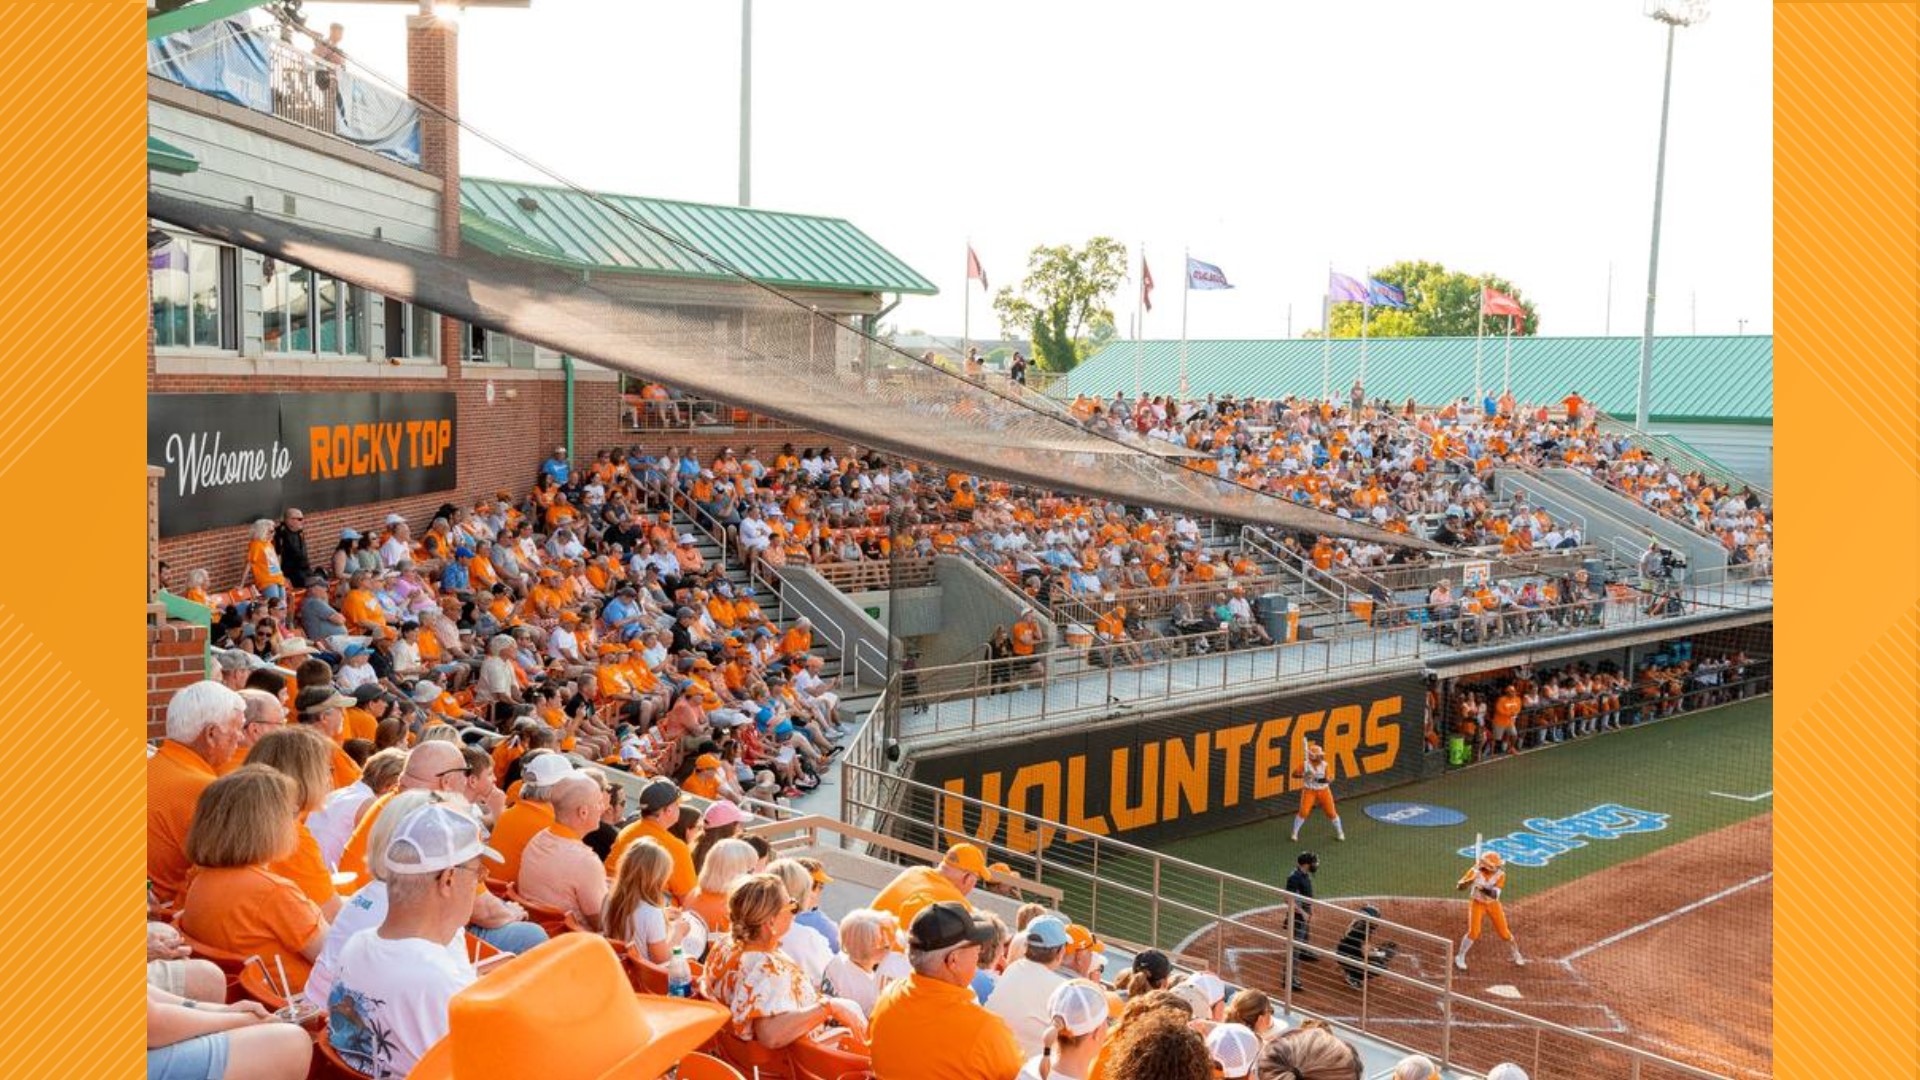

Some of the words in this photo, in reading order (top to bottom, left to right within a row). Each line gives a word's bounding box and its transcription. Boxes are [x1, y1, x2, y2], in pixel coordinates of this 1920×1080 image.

[165, 431, 268, 497] Welcome
[271, 440, 292, 479] to
[309, 422, 402, 481] ROCKY
[405, 419, 451, 468] TOP
[943, 695, 1402, 856] VOLUNTEERS
